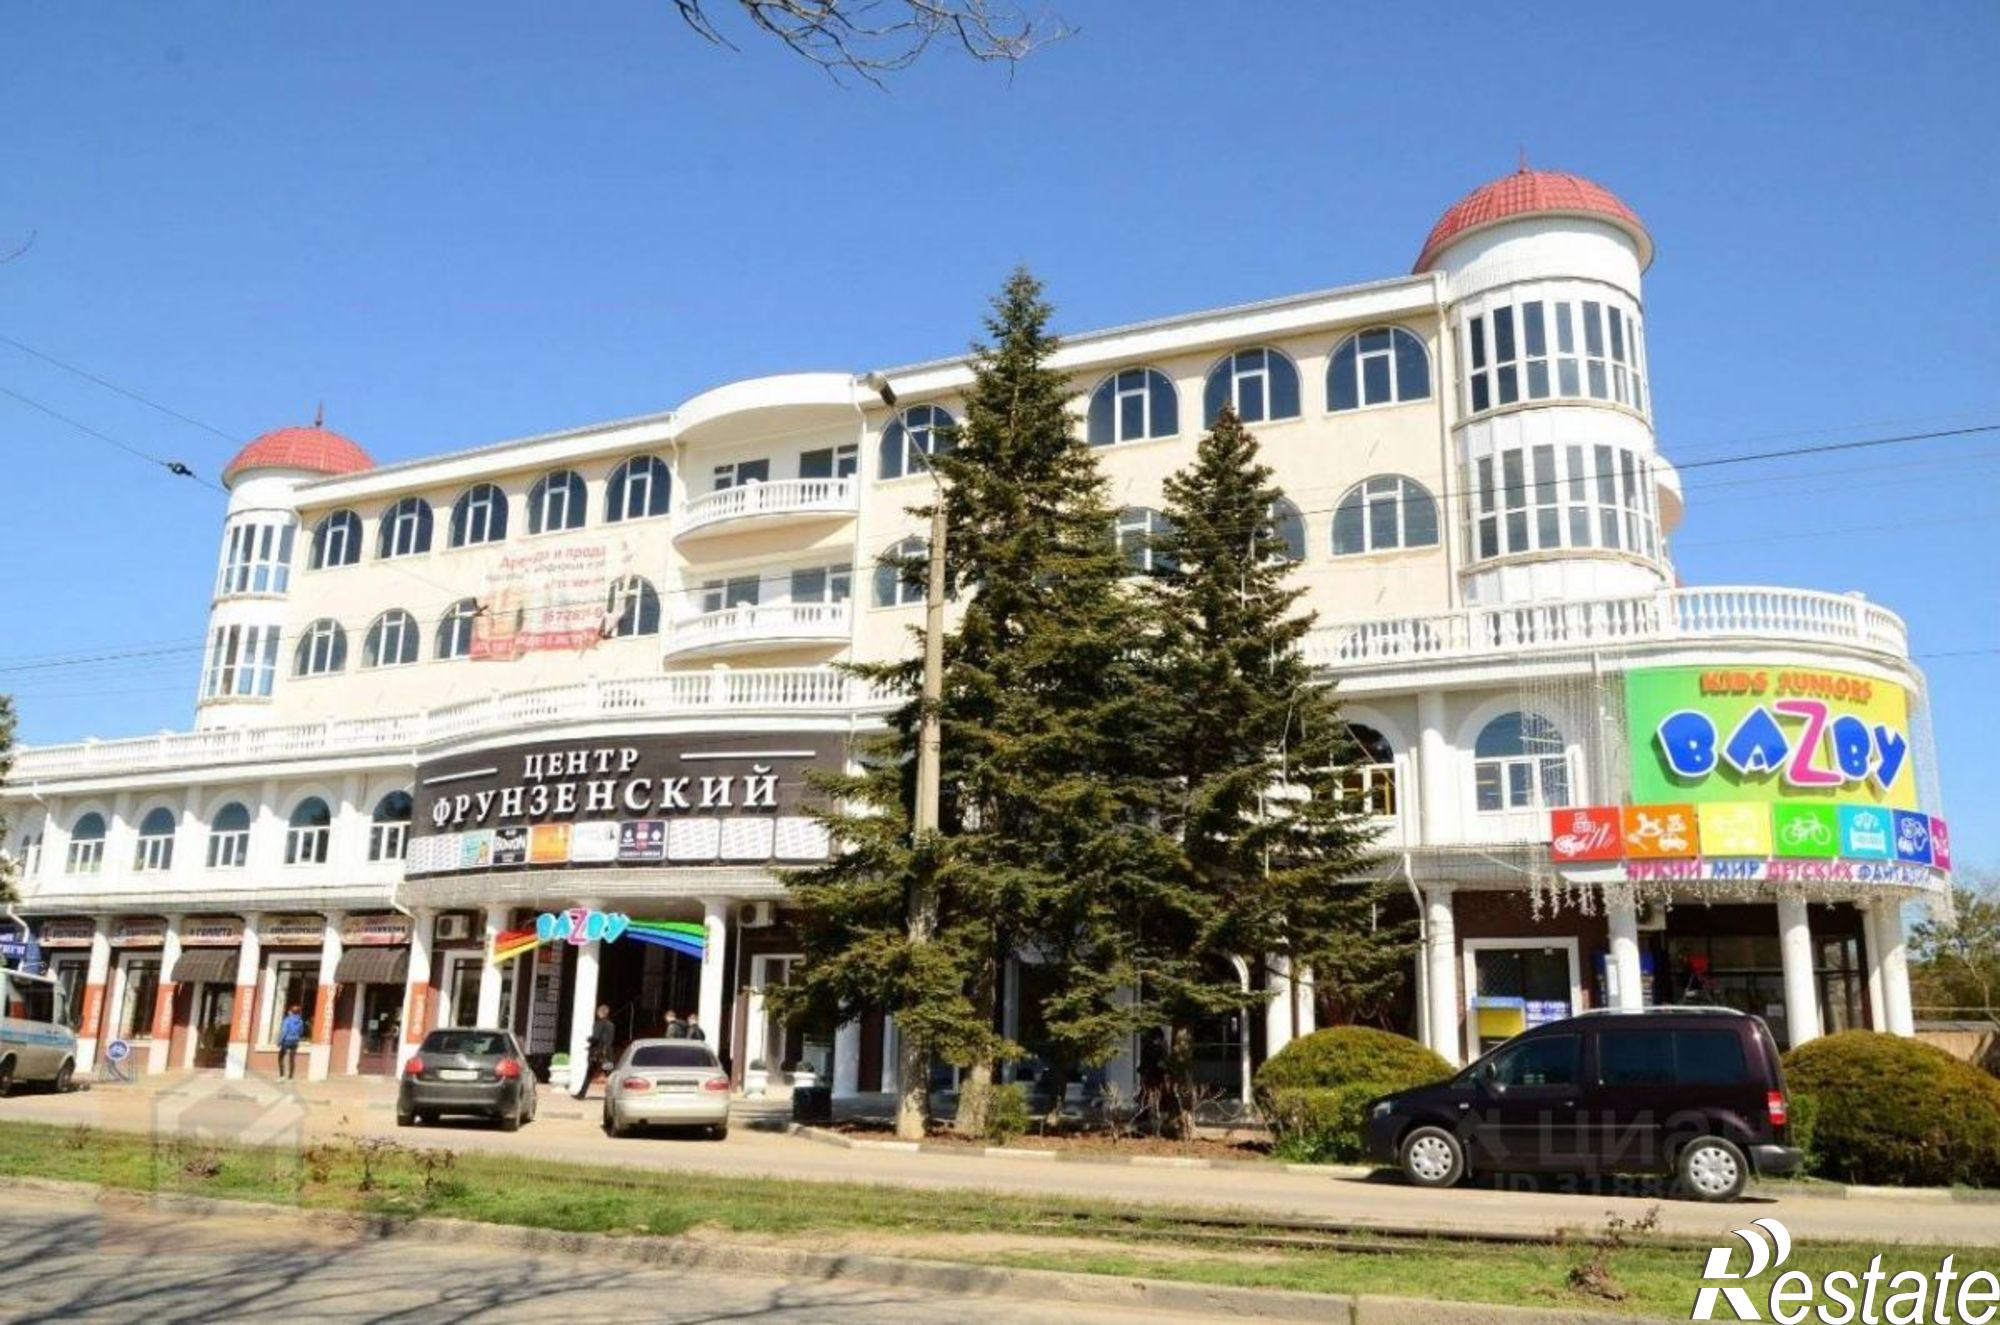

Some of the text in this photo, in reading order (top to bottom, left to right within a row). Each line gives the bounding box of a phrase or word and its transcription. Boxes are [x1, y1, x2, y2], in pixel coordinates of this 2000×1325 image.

[1700, 671, 1873, 703] KIDS JUNIORS
[1656, 698, 1910, 792] BAZBY
[524, 748, 639, 783] ЦЕНТР
[432, 763, 778, 828] ФРУНЗЕНСКИЙ
[1712, 859, 1760, 877] МИР
[536, 907, 630, 945] BAZBY
